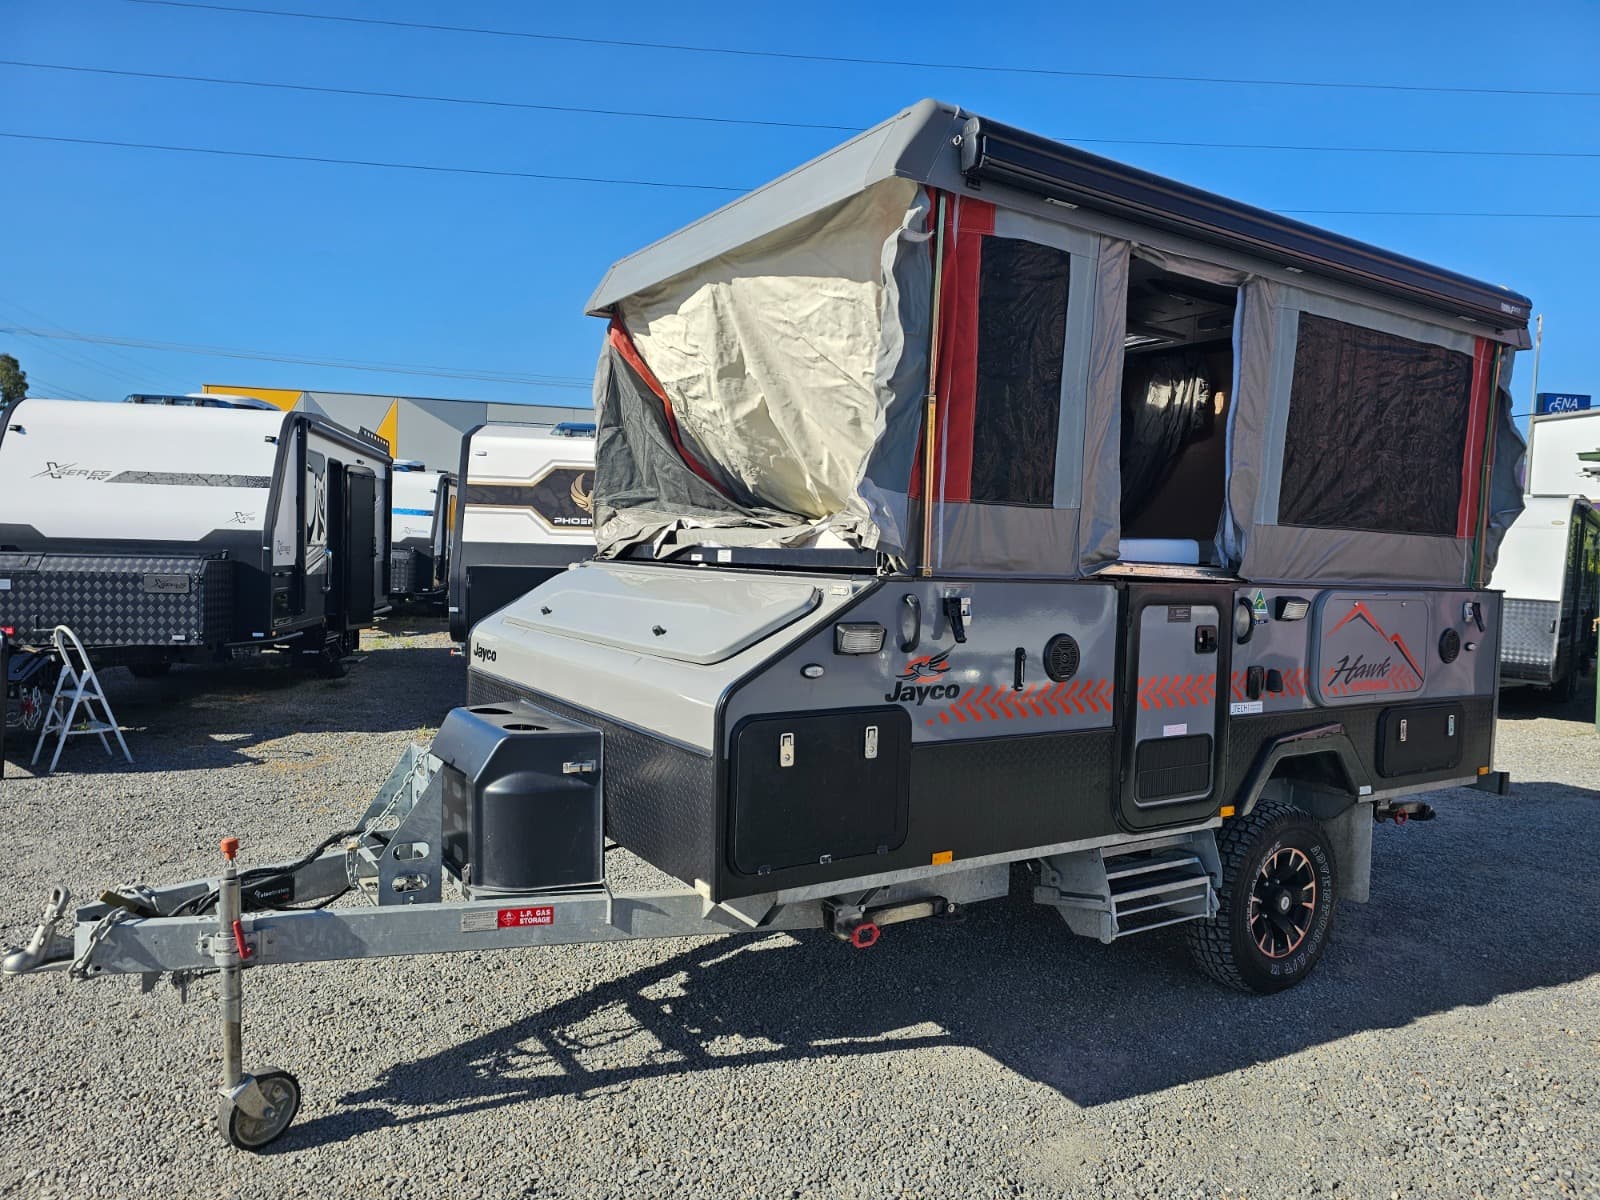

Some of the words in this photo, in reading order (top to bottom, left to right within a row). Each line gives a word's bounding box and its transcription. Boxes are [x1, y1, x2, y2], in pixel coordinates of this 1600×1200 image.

[474, 642, 497, 662] Jayco
[1328, 655, 1391, 686] Hawk
[885, 681, 960, 705] Jayco
[520, 916, 551, 924] STORAGE
